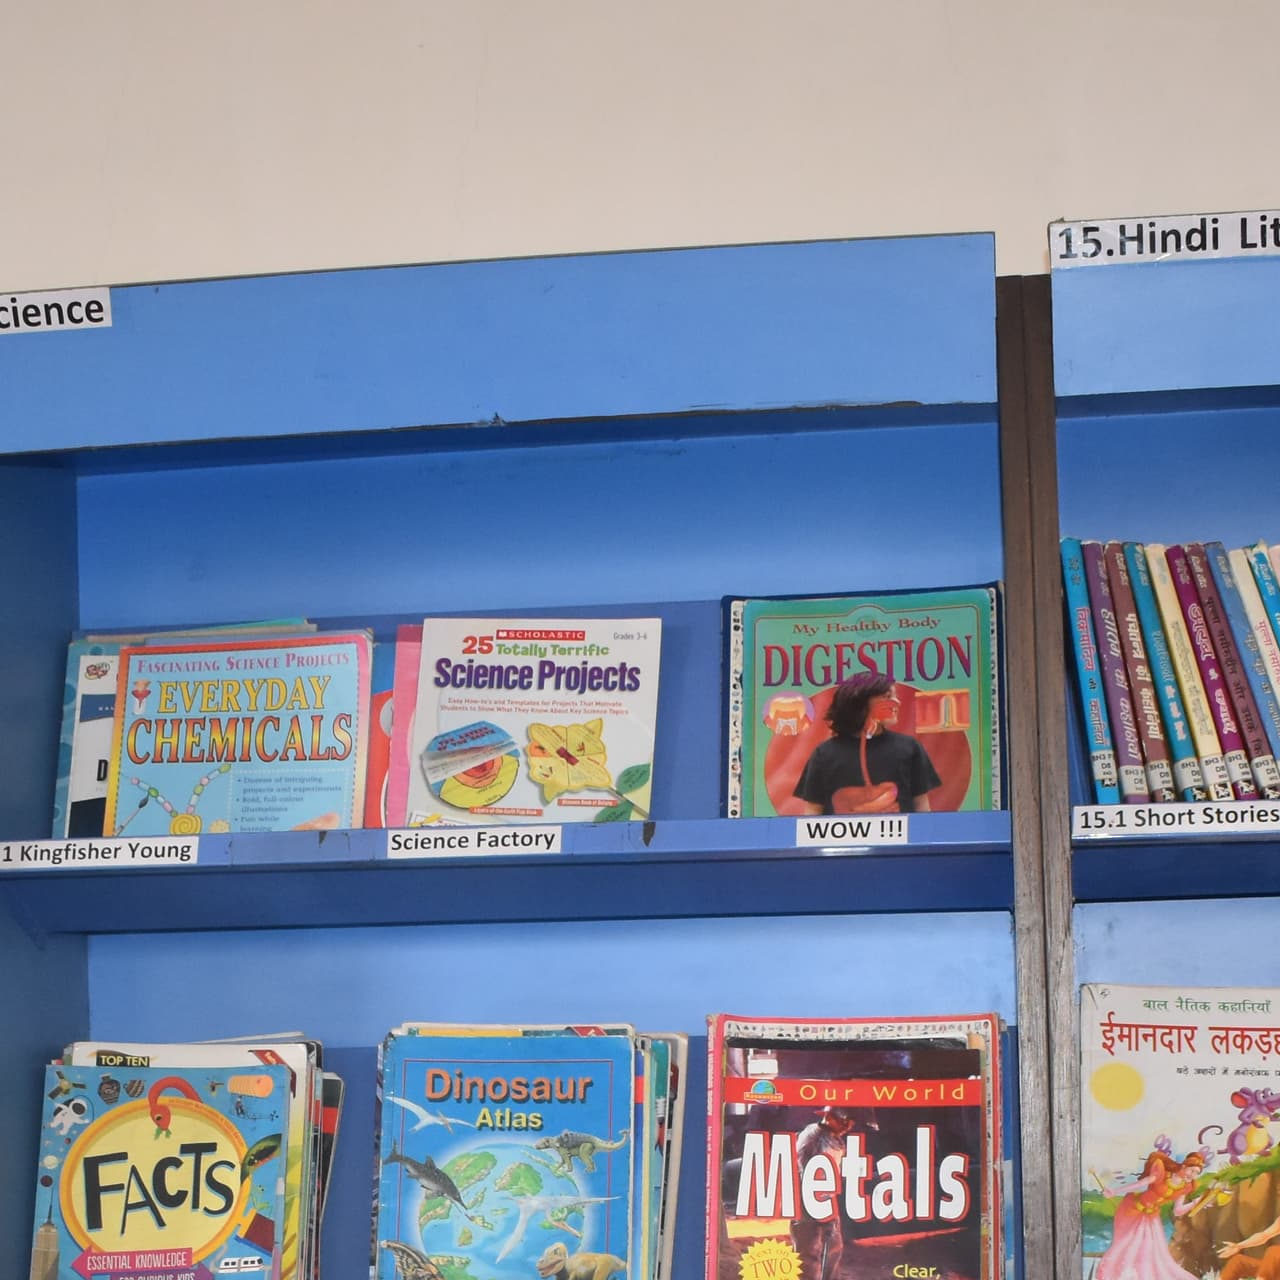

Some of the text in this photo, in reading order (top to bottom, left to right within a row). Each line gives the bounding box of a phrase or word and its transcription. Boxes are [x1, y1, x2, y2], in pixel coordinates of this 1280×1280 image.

[1058, 216, 1219, 260] 15.Hindi
[508, 631, 584, 640] SCHOLASTIC
[793, 615, 942, 636] My Healthy Body
[462, 636, 610, 658] 25 Totally Terrific
[762, 635, 974, 688] DIGESTION
[433, 657, 641, 695] Science Projects
[158, 675, 331, 714] EVERYDAY
[125, 713, 354, 766] CHEMICALS
[1081, 811, 1126, 829] 15.1
[1135, 808, 1195, 826] Short
[1203, 806, 1280, 824] Stories
[807, 819, 904, 840] WOW !!!
[20, 842, 122, 862] Kingfisher
[128, 842, 192, 864] Young
[391, 830, 555, 853] Science Factory
[1099, 1011, 1198, 1056] ईमानदार
[100, 1055, 149, 1067] TOP TEN
[424, 1068, 593, 1104] Dinosaur
[799, 1083, 966, 1101] Our World
[475, 1107, 544, 1131] Atlas
[735, 1123, 972, 1224] Metals
[82, 1142, 236, 1236] FACTS
[87, 1251, 187, 1270] ESSENTIAL KNOWLEDGE
[893, 1263, 941, 1280] Clear,
